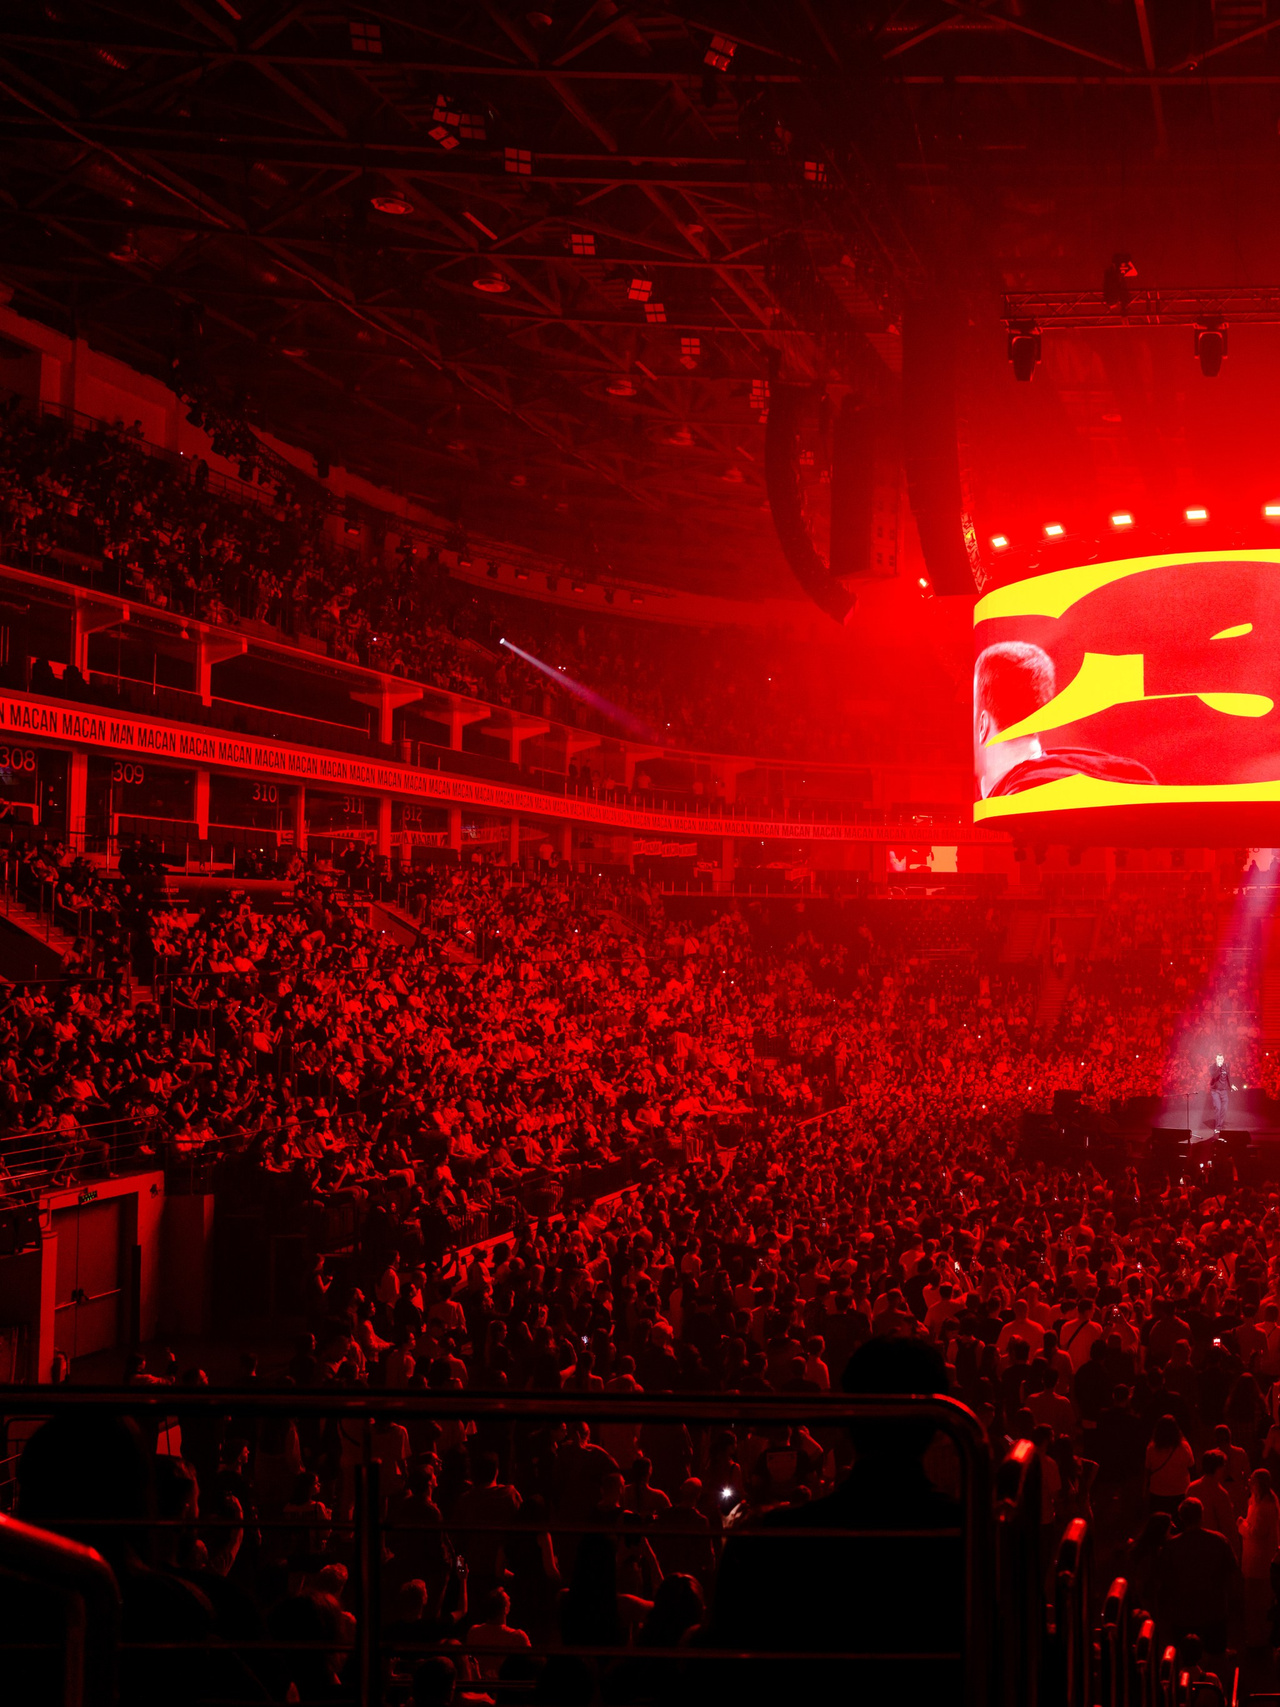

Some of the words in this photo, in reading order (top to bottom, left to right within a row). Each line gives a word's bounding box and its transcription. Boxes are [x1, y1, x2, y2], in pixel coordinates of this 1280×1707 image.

[0, 746, 35, 772] 308
[10, 704, 57, 732] MACAN
[62, 713, 105, 741] MACAN
[109, 721, 134, 746] MAN
[137, 726, 175, 752] MACAN
[180, 734, 214, 758] MACAN
[218, 741, 252, 764] MACAN
[254, 748, 285, 770] MACAN
[288, 754, 316, 775] MACAN
[320, 759, 346, 779] MACAN
[349, 764, 374, 783] MACAN
[377, 769, 401, 787] MACAN
[724, 823, 750, 834] MACAN
[752, 825, 779, 835] MACAN
[782, 826, 810, 836] MACAN
[812, 827, 842, 837] MACAN
[113, 762, 144, 784] 309
[252, 783, 277, 803] 310
[343, 797, 363, 814] 311
